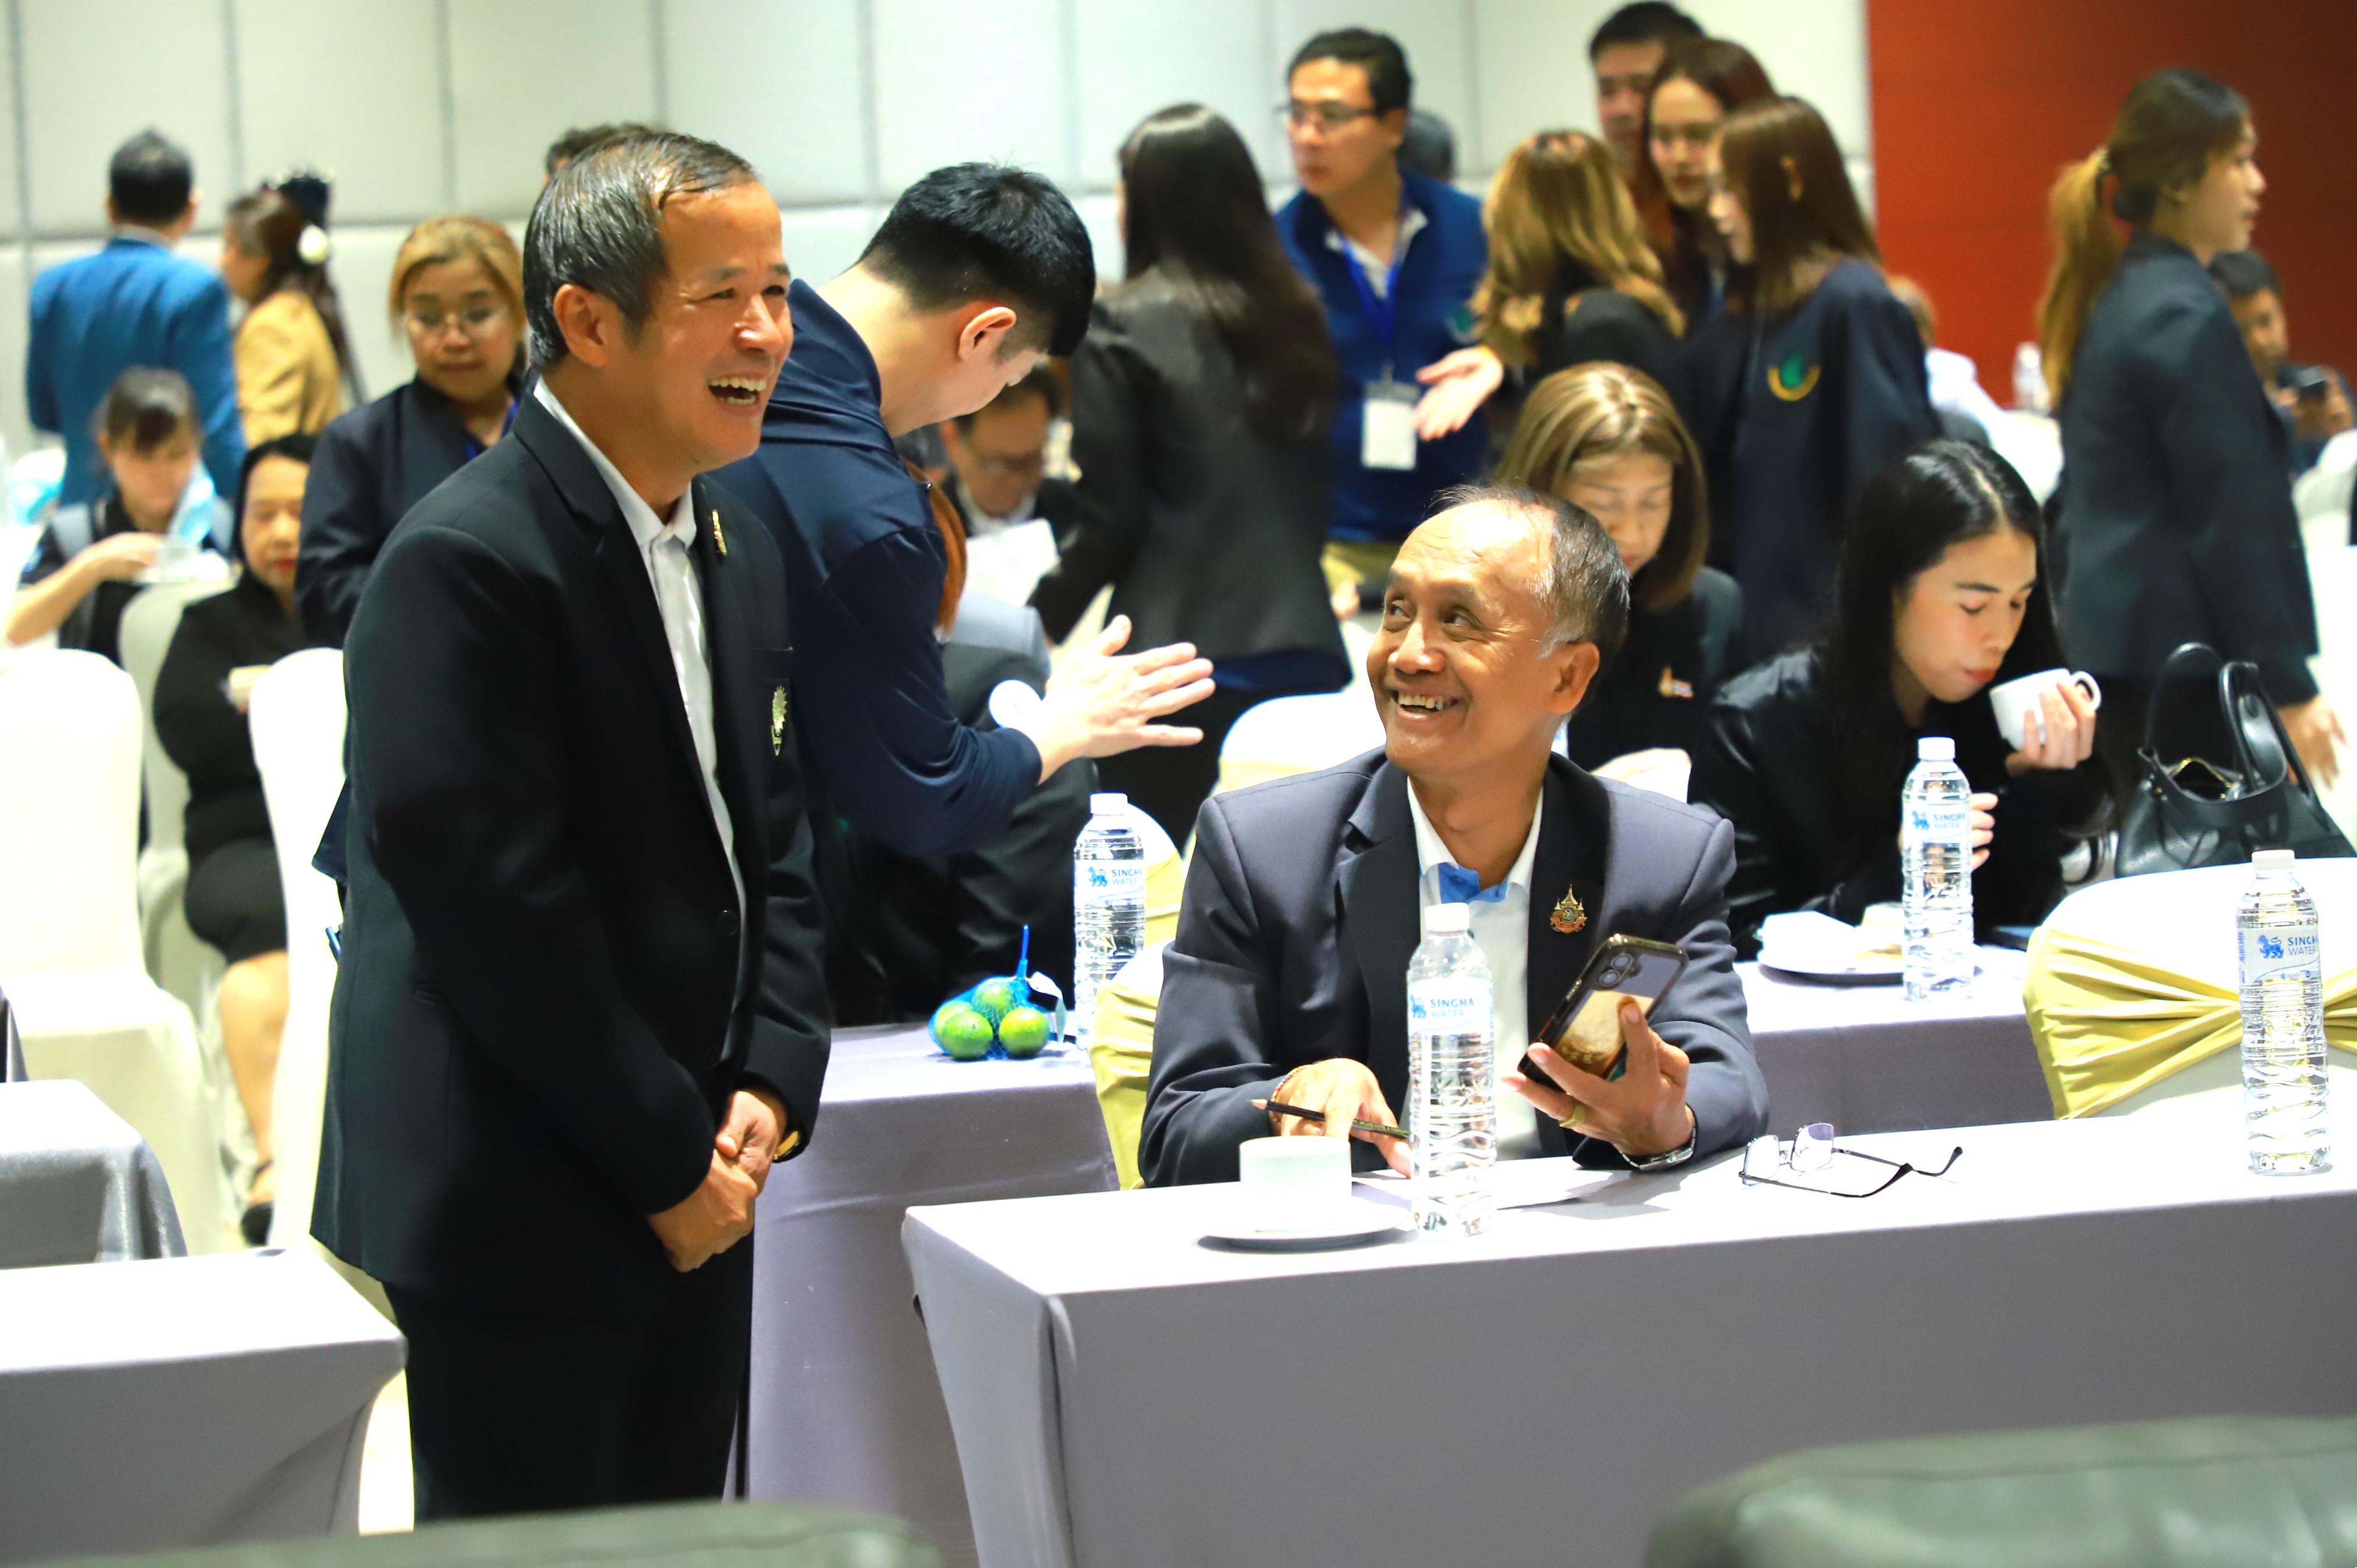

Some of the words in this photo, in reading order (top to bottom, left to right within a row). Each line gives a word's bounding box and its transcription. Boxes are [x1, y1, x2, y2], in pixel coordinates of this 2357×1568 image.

[2287, 935, 2319, 946] SINGH
[1430, 998, 1474, 1008] SINGHA
[1430, 1009, 1465, 1017] WATER
